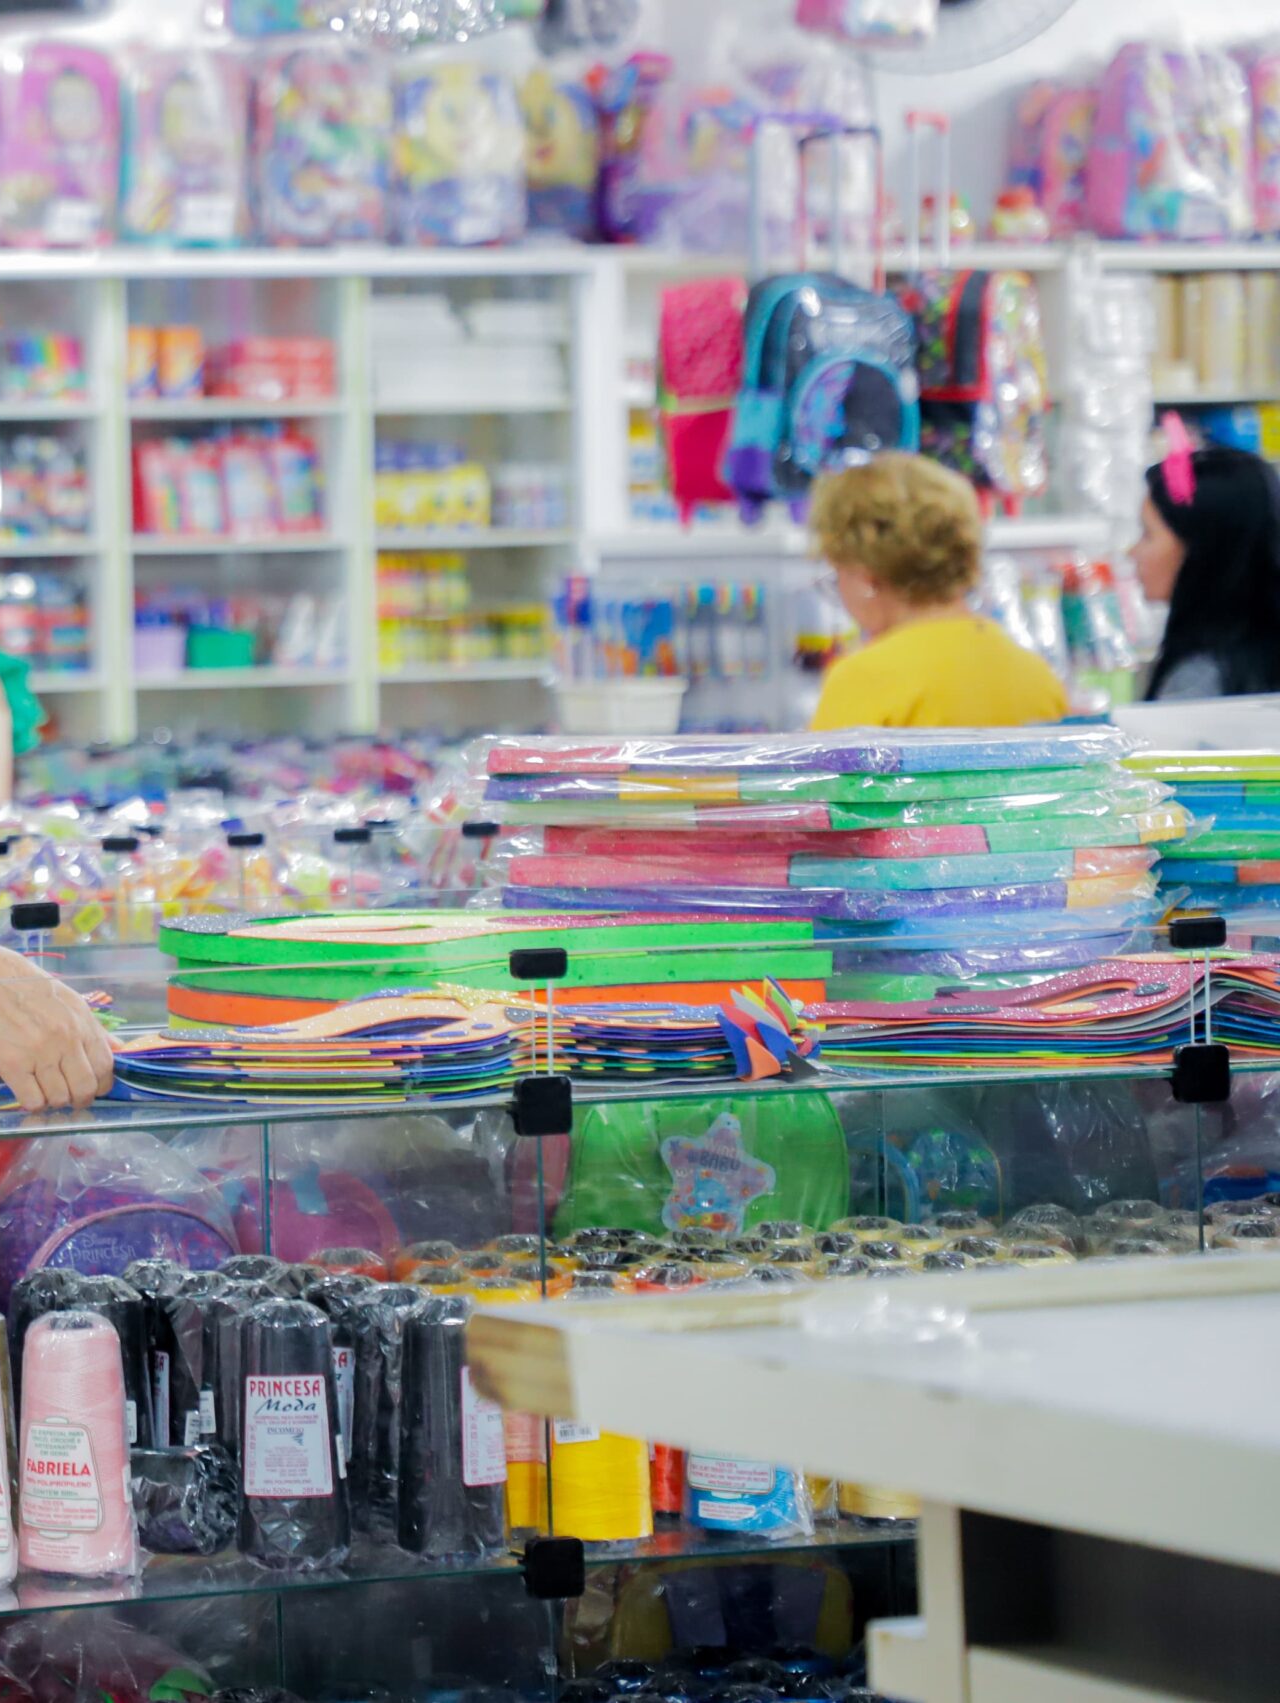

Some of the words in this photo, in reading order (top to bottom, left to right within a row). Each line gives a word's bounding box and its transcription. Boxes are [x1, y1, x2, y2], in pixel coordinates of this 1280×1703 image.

[250, 1379, 321, 1398] PRINCESA
[256, 1398, 317, 1415] Moda
[26, 1458, 91, 1476] FABRIELA
